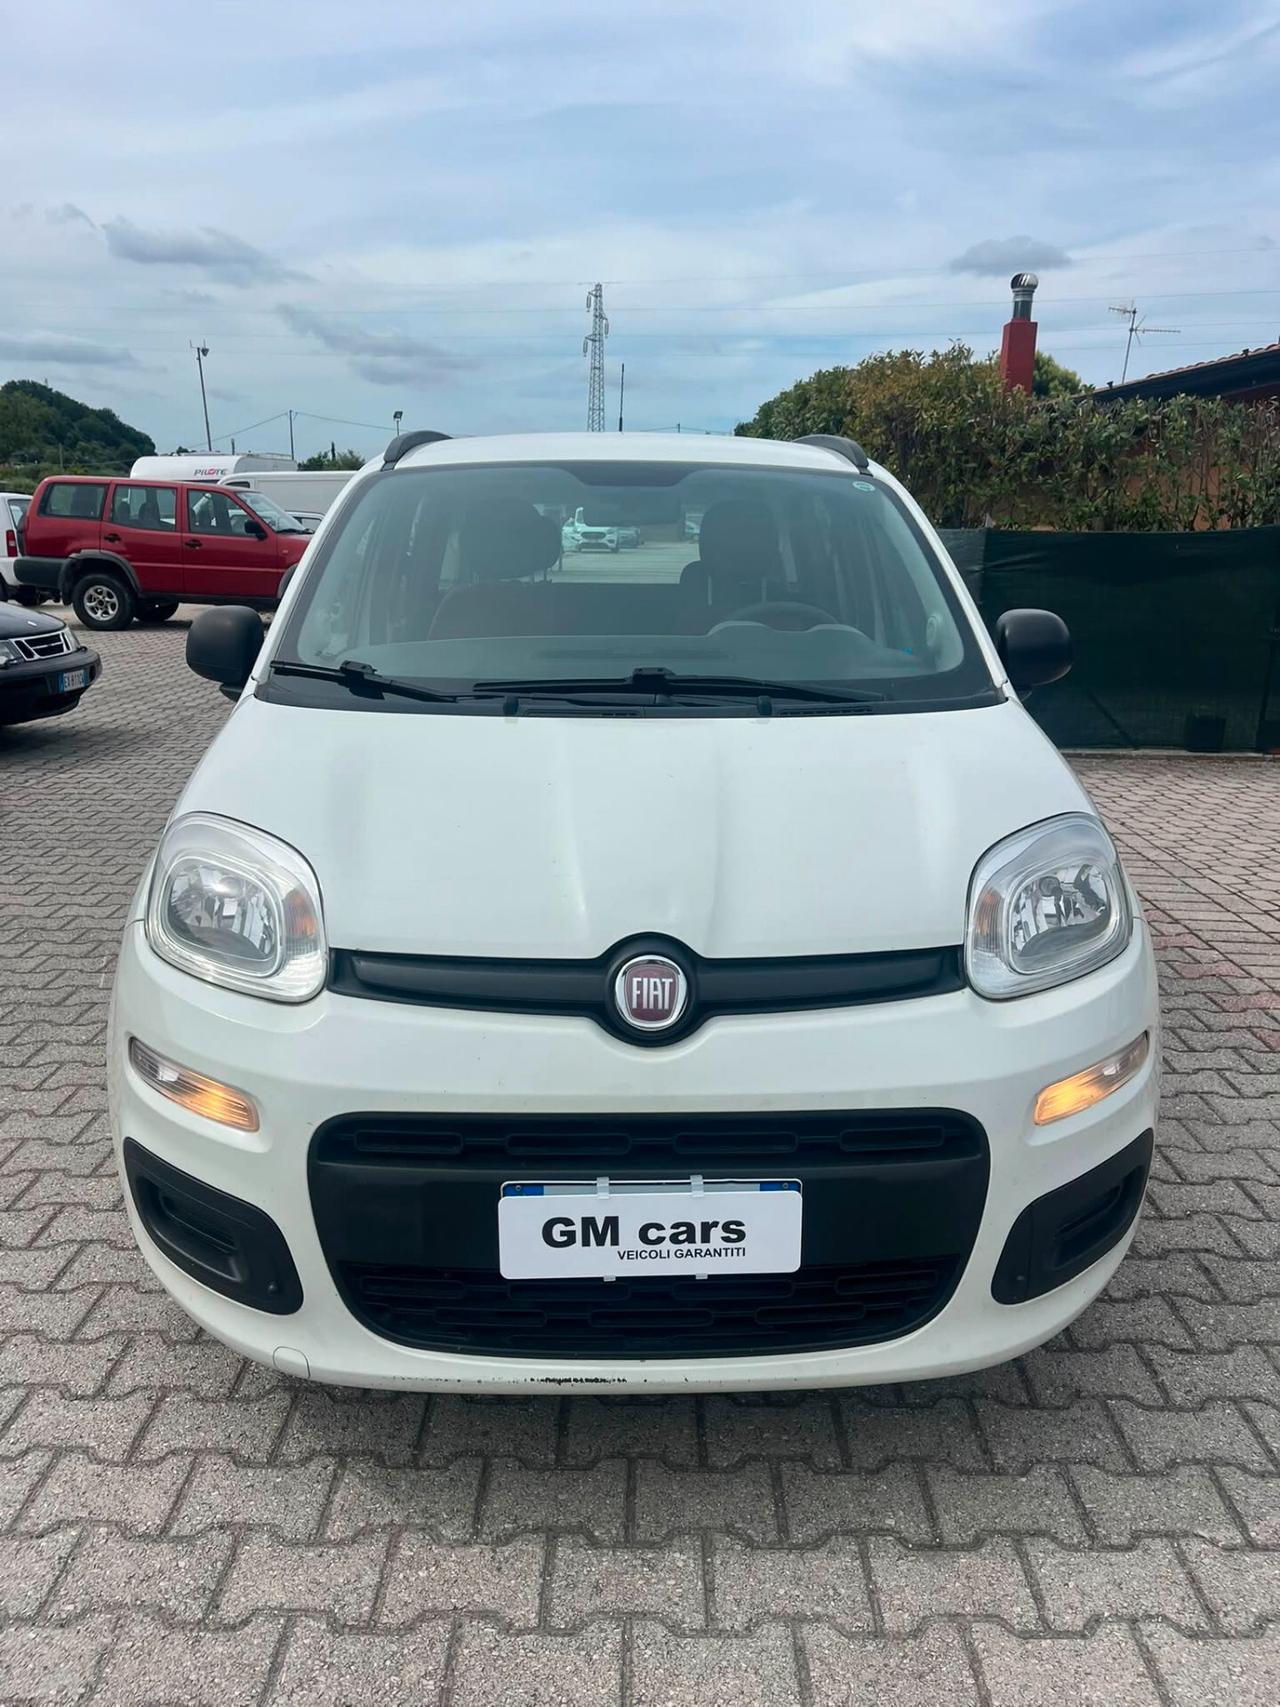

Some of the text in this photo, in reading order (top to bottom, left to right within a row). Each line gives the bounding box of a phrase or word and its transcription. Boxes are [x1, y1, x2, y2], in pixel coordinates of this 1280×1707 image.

[194, 468, 227, 476] PILOTE
[632, 977, 674, 1010] FIAT
[541, 1215, 747, 1249] GM cars
[617, 1247, 746, 1261] VEICOLI GARANTITI
